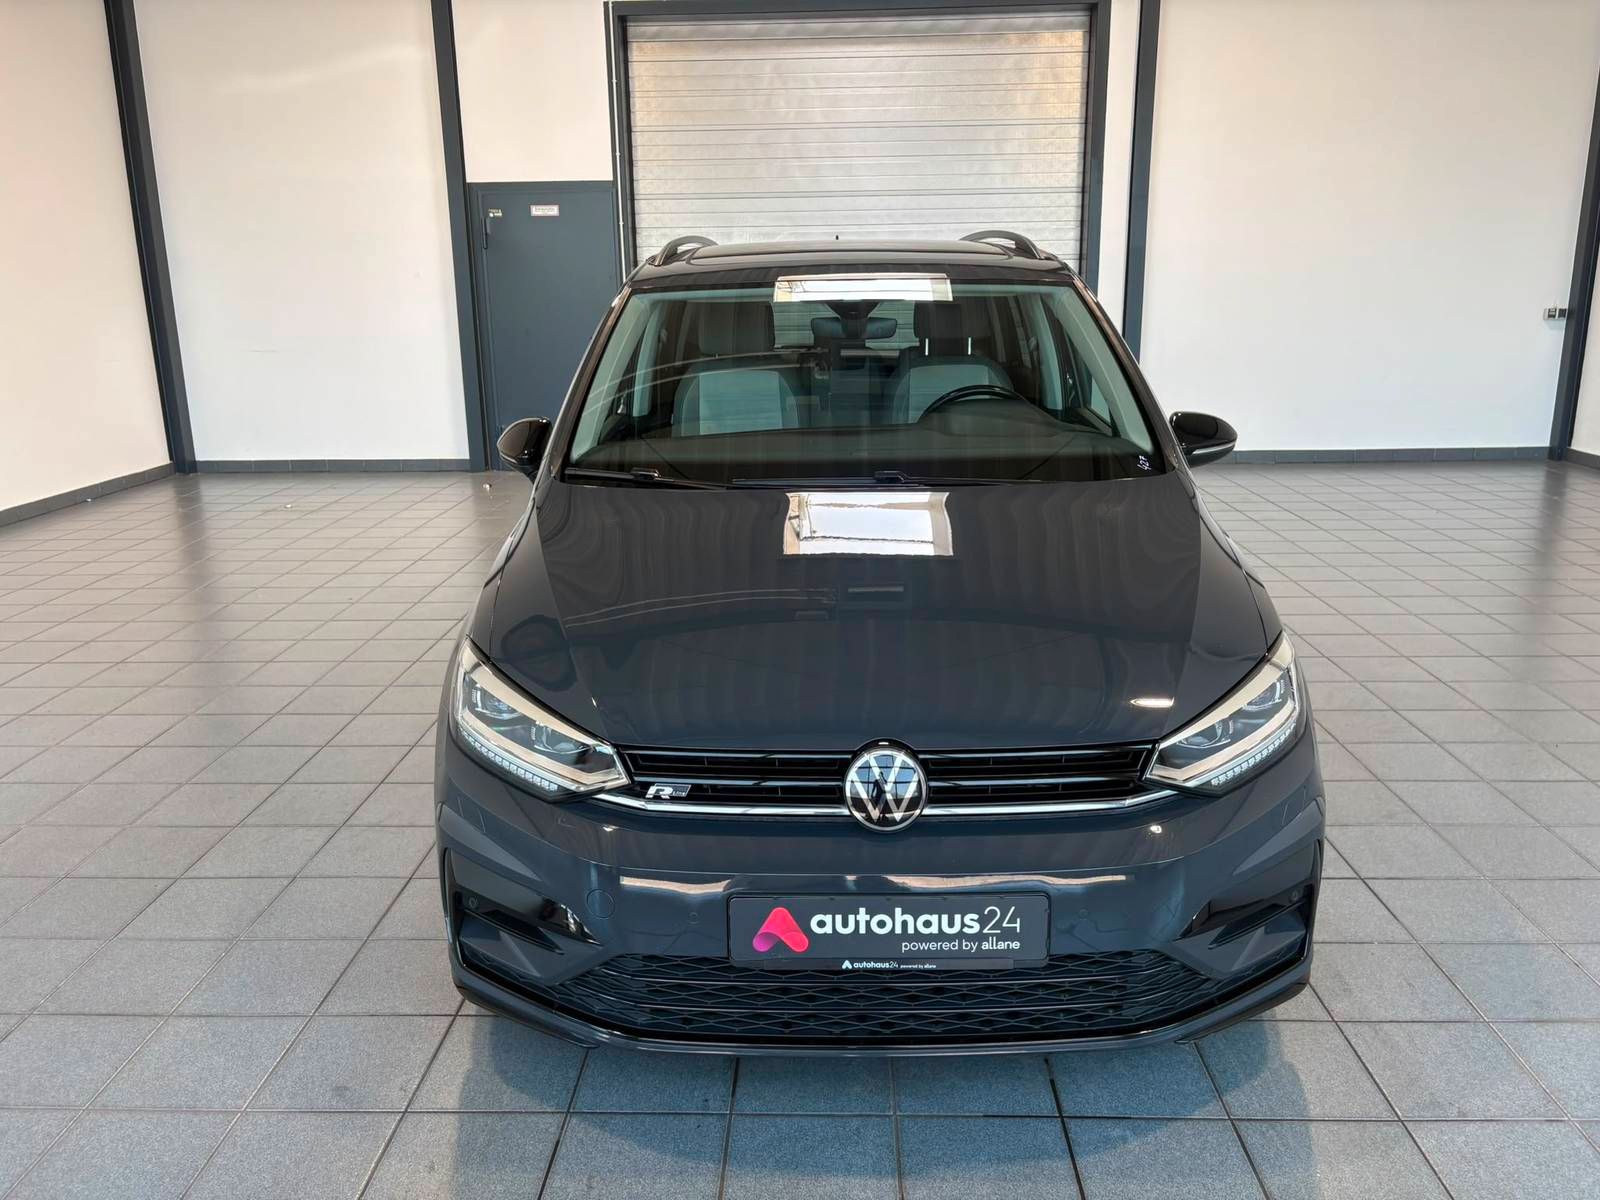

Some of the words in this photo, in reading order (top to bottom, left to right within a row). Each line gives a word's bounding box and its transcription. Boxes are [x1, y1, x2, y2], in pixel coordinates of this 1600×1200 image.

[645, 785, 673, 799] R
[810, 906, 1020, 934] autohaus24
[902, 939, 958, 953] powered
[962, 939, 978, 953] by
[981, 937, 1020, 950] allane
[853, 961, 899, 969] autohaus24
